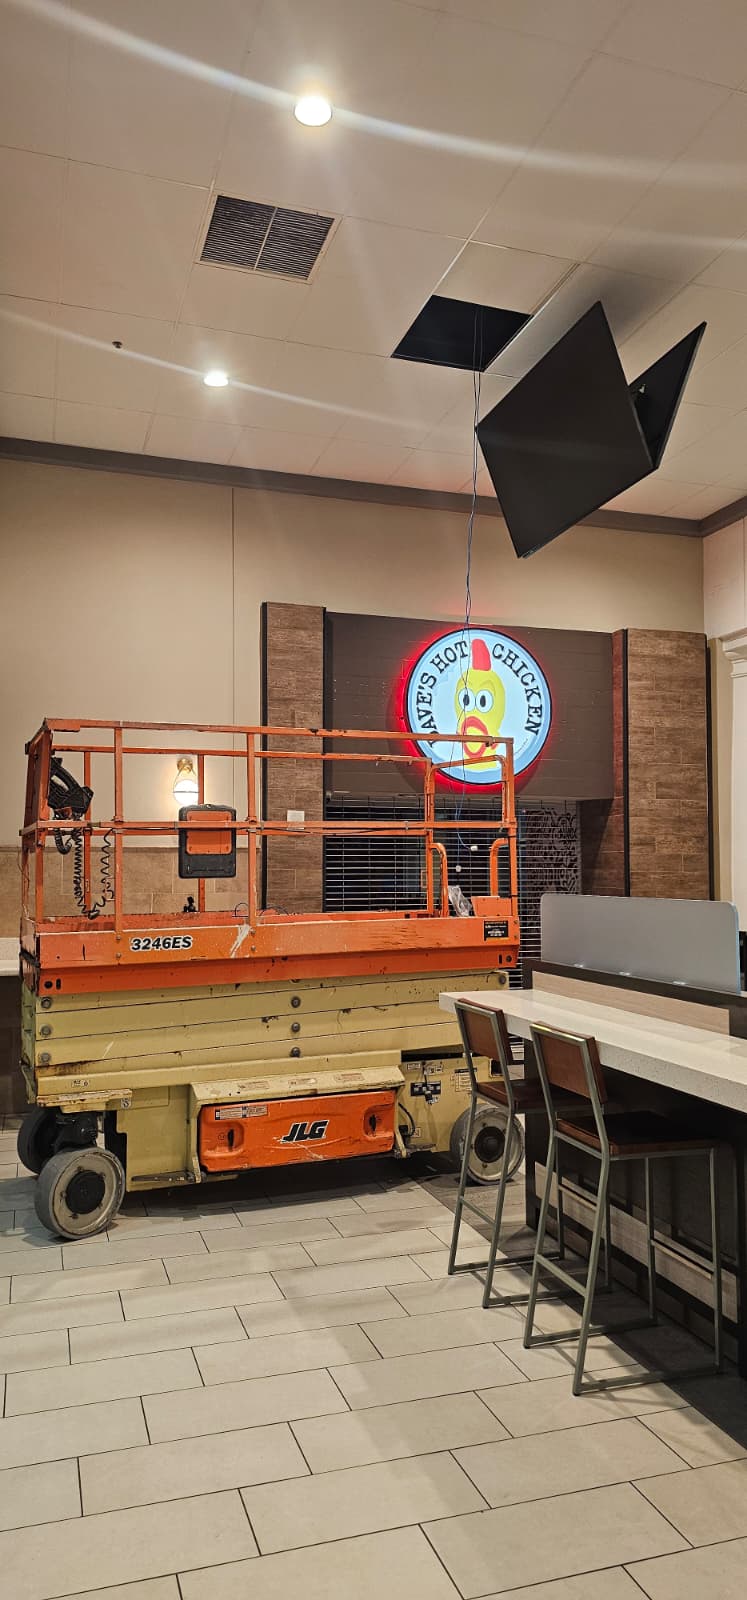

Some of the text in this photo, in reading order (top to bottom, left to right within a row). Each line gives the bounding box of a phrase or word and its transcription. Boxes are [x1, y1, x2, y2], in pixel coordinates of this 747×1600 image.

[430, 640, 468, 674] HOT
[492, 643, 543, 736] CHICKEN
[131, 936, 192, 951] 3246ES
[281, 1120, 329, 1143] JLG
